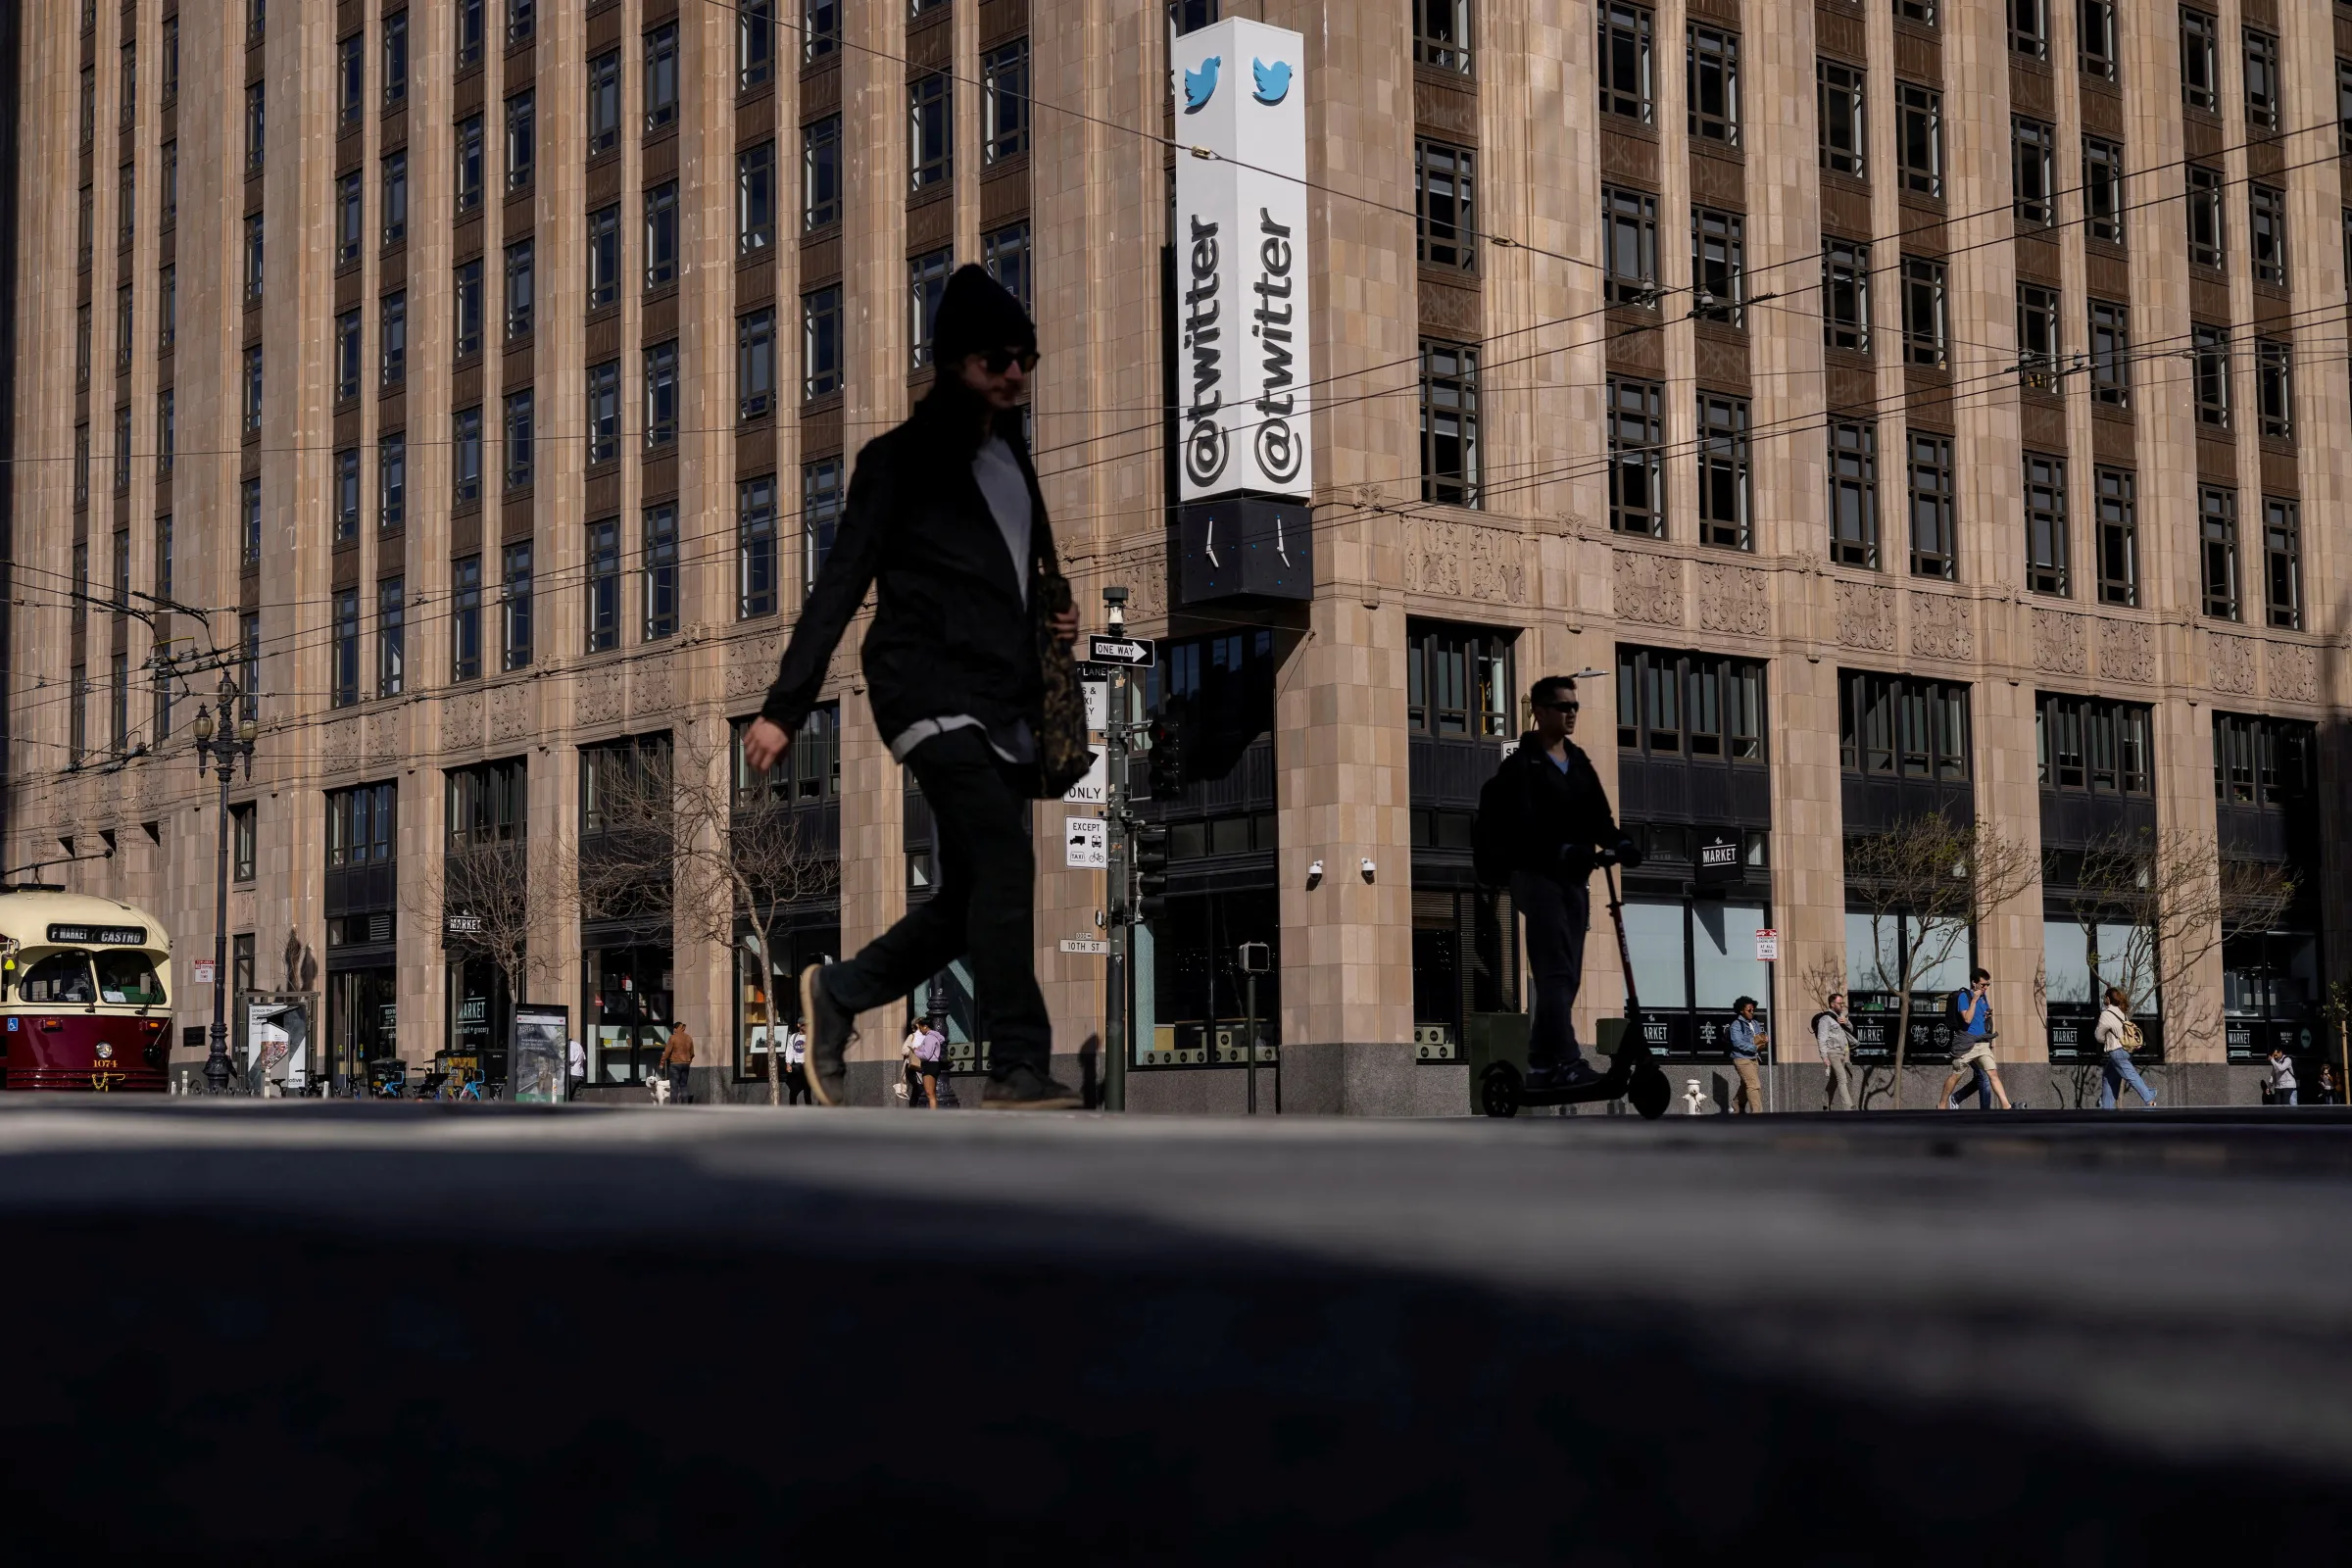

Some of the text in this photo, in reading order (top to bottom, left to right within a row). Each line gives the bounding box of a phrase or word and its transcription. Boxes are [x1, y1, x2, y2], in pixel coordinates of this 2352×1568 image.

[1184, 214, 1230, 487] @twitter
[1252, 207, 1302, 484] @twitter
[1098, 644, 1134, 656] ONE WAY
[1069, 787, 1101, 799] ONLY
[1072, 822, 1101, 832] EXCEPT
[1702, 848, 1737, 863] MARKET
[450, 918, 481, 930] MARKET
[51, 928, 140, 944] F MARKET CASTRO
[1067, 942, 1101, 952] 10TH ST
[458, 1002, 485, 1019] MARKET
[1643, 1026, 1667, 1040] ARKET
[1857, 1029, 1884, 1042] MARKET
[2053, 1030, 2078, 1043] MARKET
[2228, 1032, 2250, 1045] MARKET
[93, 1059, 118, 1068] 1074
